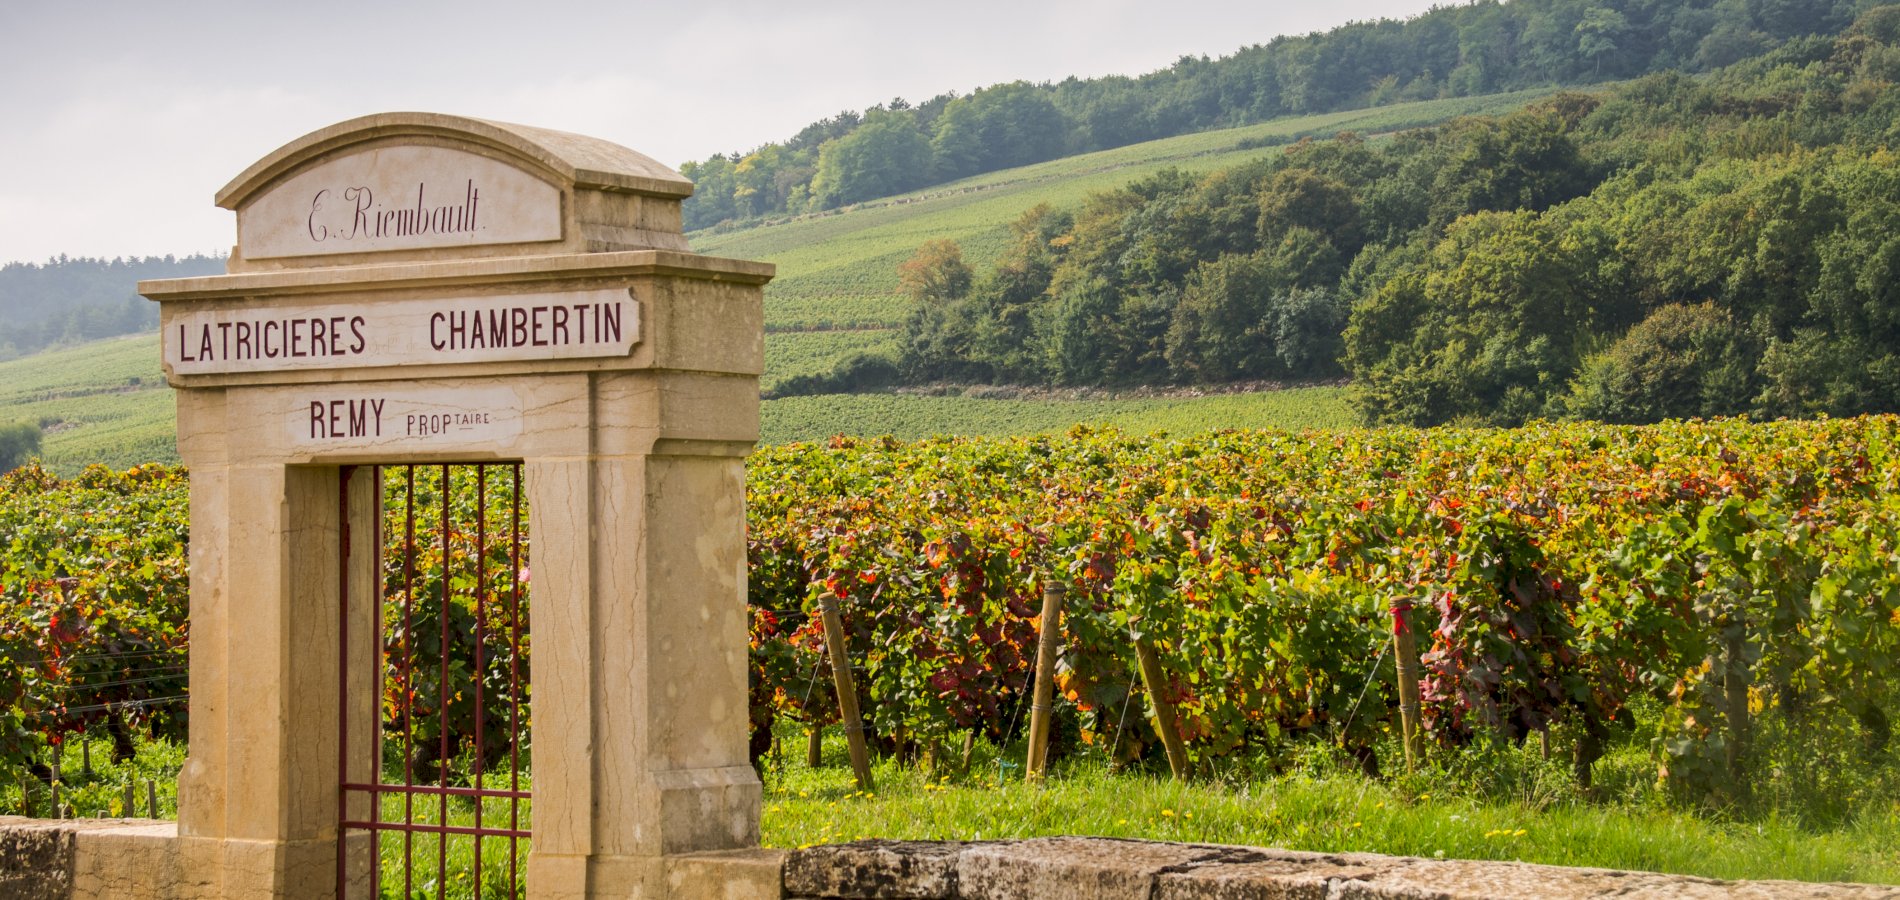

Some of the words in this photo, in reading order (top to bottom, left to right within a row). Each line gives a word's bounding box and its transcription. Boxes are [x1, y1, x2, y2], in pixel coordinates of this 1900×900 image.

[179, 315, 366, 362] LATRICIERES
[429, 301, 622, 351] CHAMBERTIN
[310, 398, 386, 439] REMY
